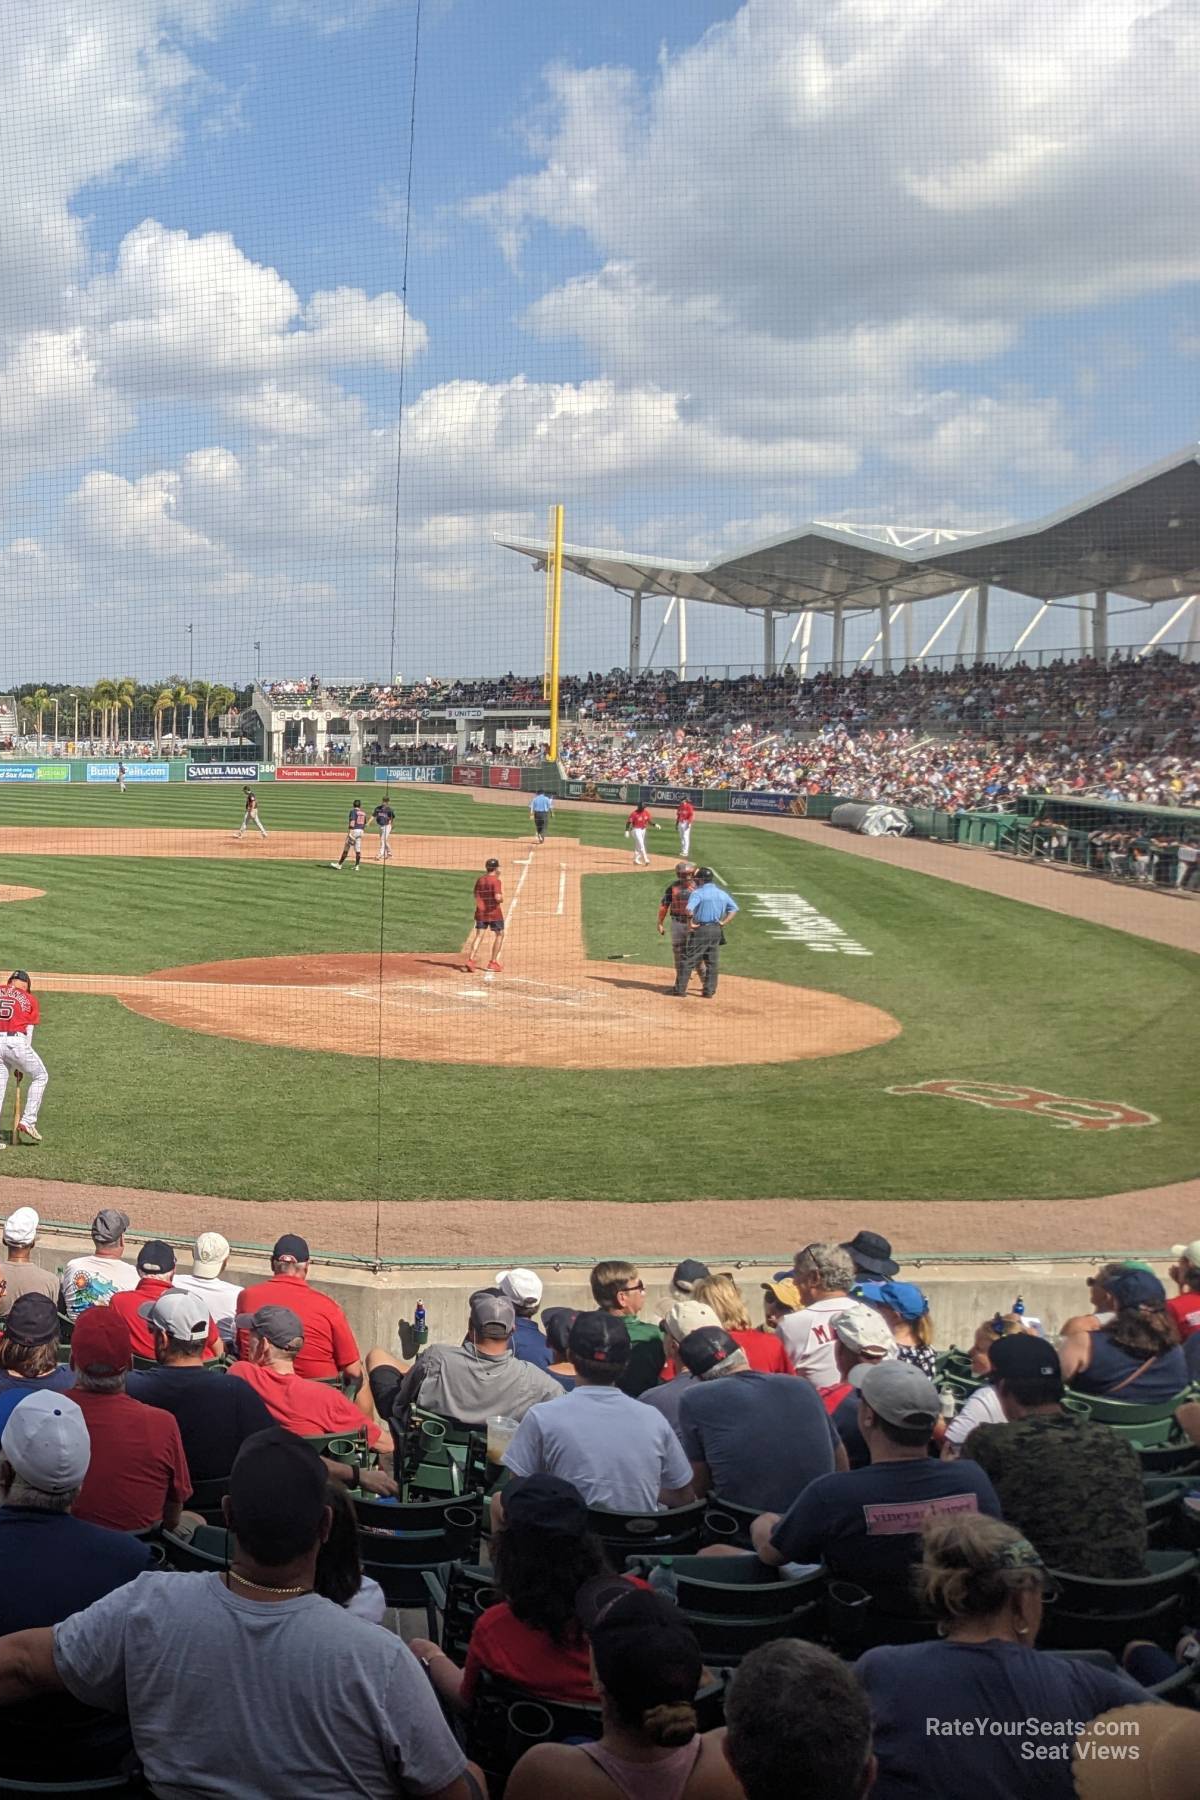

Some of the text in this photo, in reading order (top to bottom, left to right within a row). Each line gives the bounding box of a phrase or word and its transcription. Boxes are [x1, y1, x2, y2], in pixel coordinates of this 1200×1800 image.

[188, 766, 256, 777] SAMUEL ADAMS
[260, 764, 275, 773] 380
[321, 769, 351, 778] University
[414, 767, 436, 781] CAFE
